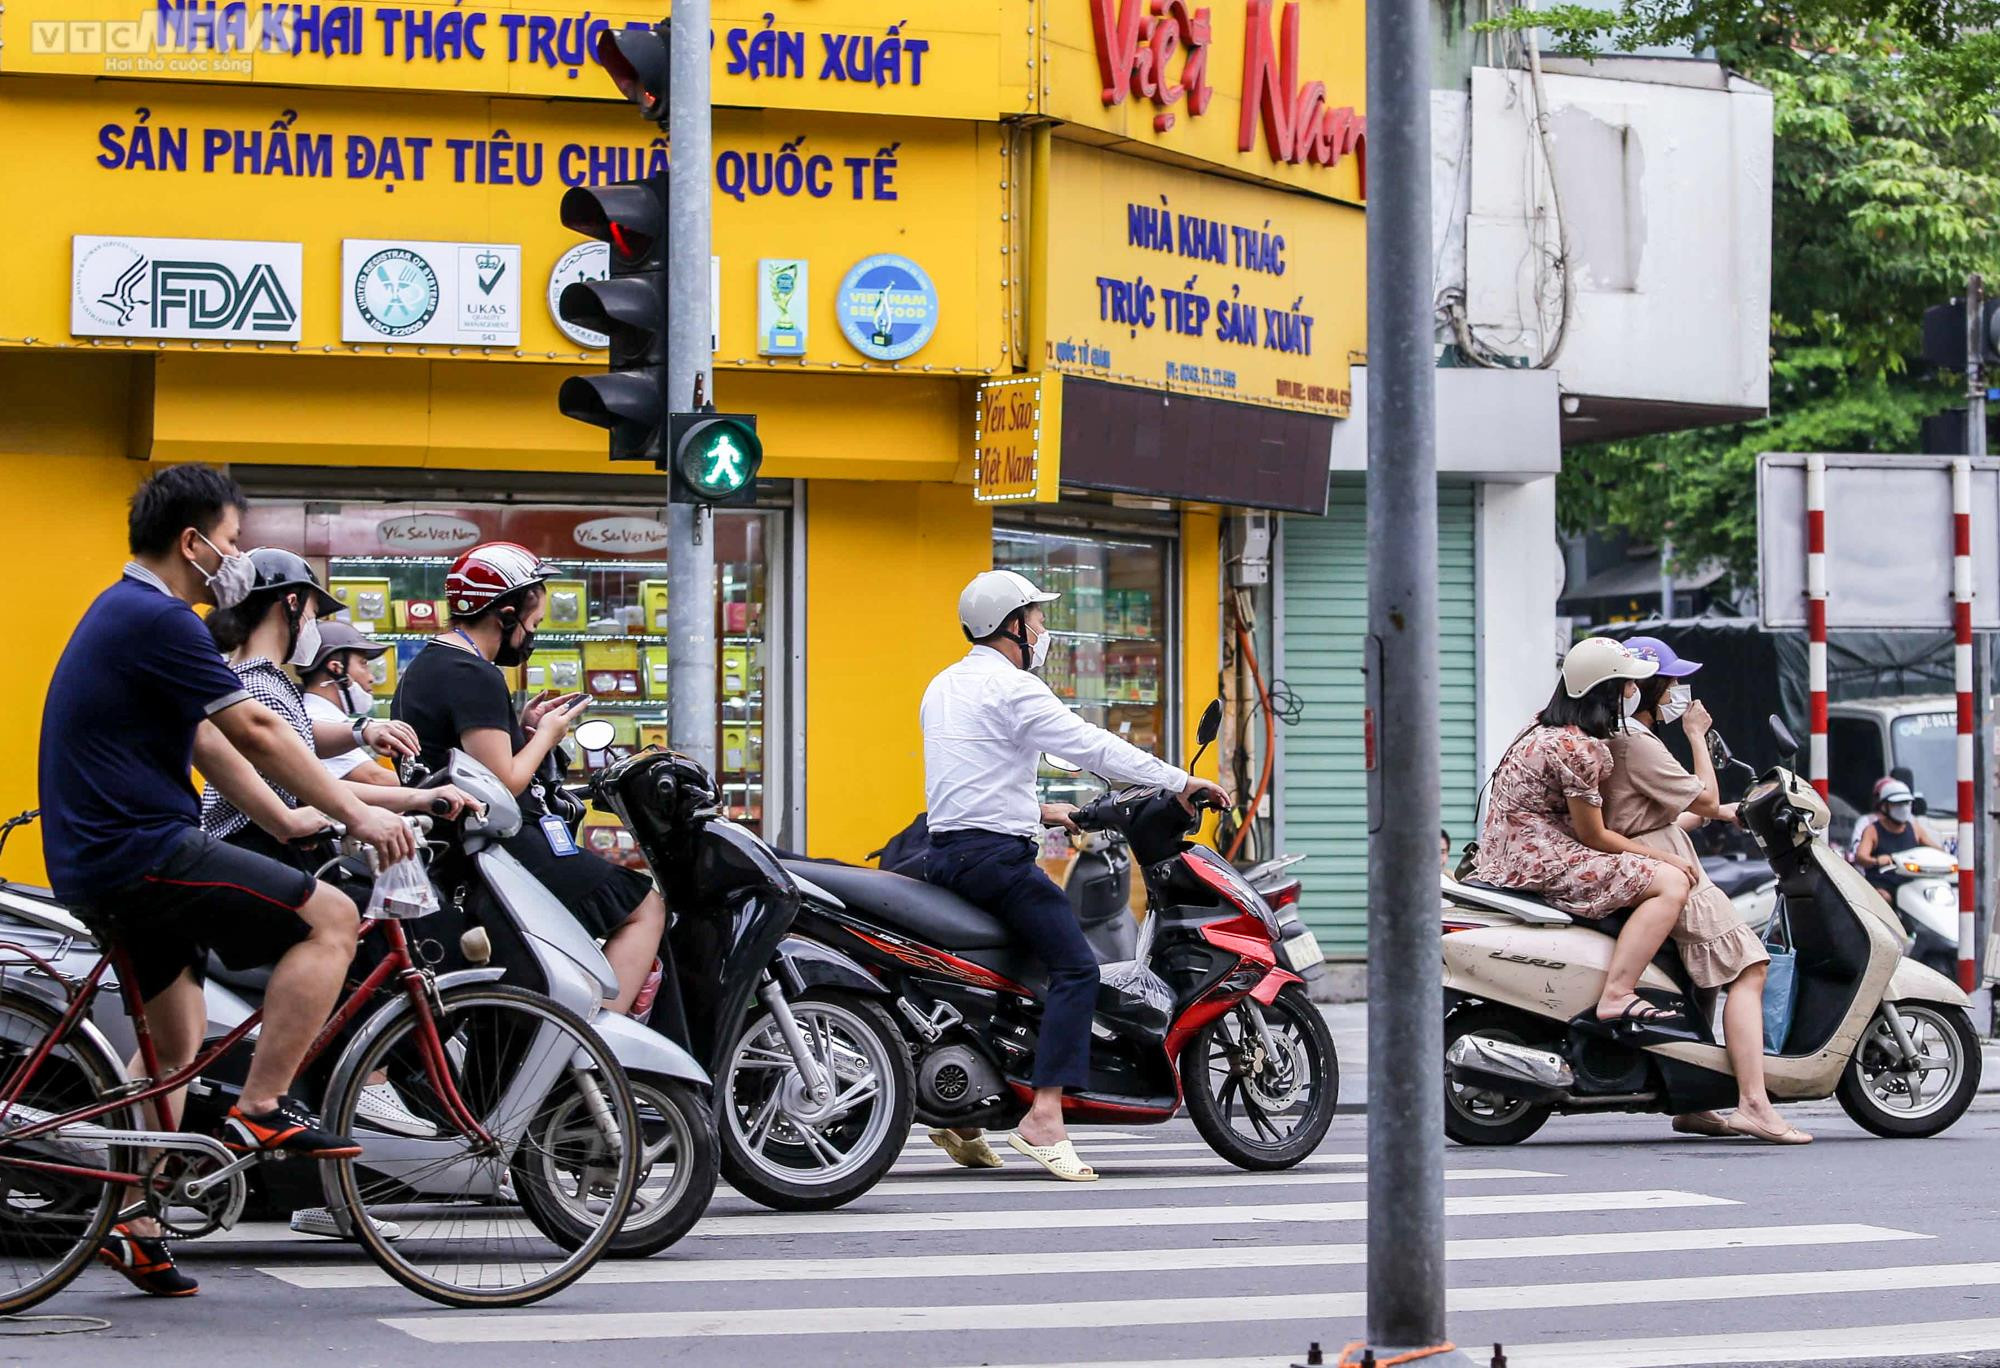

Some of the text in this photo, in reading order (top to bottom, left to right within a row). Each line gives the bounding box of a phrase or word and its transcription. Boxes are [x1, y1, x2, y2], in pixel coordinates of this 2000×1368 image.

[262, 3, 362, 59] KHAI
[727, 12, 804, 80] SẢN
[819, 20, 929, 88] XUẤT
[97, 107, 188, 172] SẢN
[203, 109, 334, 178] PHẨM
[345, 135, 432, 193] ĐẠT
[446, 128, 543, 187] TIÊU
[716, 136, 901, 202] QUỐC TẾ
[1127, 194, 1286, 277] NHÀ KHAI THÁC
[363, 250, 425, 274] REGISTRAR OF
[152, 260, 297, 331] FDA
[357, 275, 367, 310] UNITED
[467, 304, 507, 314] UKAS
[1096, 274, 1315, 356] TRỰC TIẾP SẢN XUẤT
[370, 319, 425, 336] ISO 22000
[983, 388, 1033, 435] Yến Sào
[979, 446, 1035, 494] Việt Nam
[1487, 949, 1566, 970] LEAD
